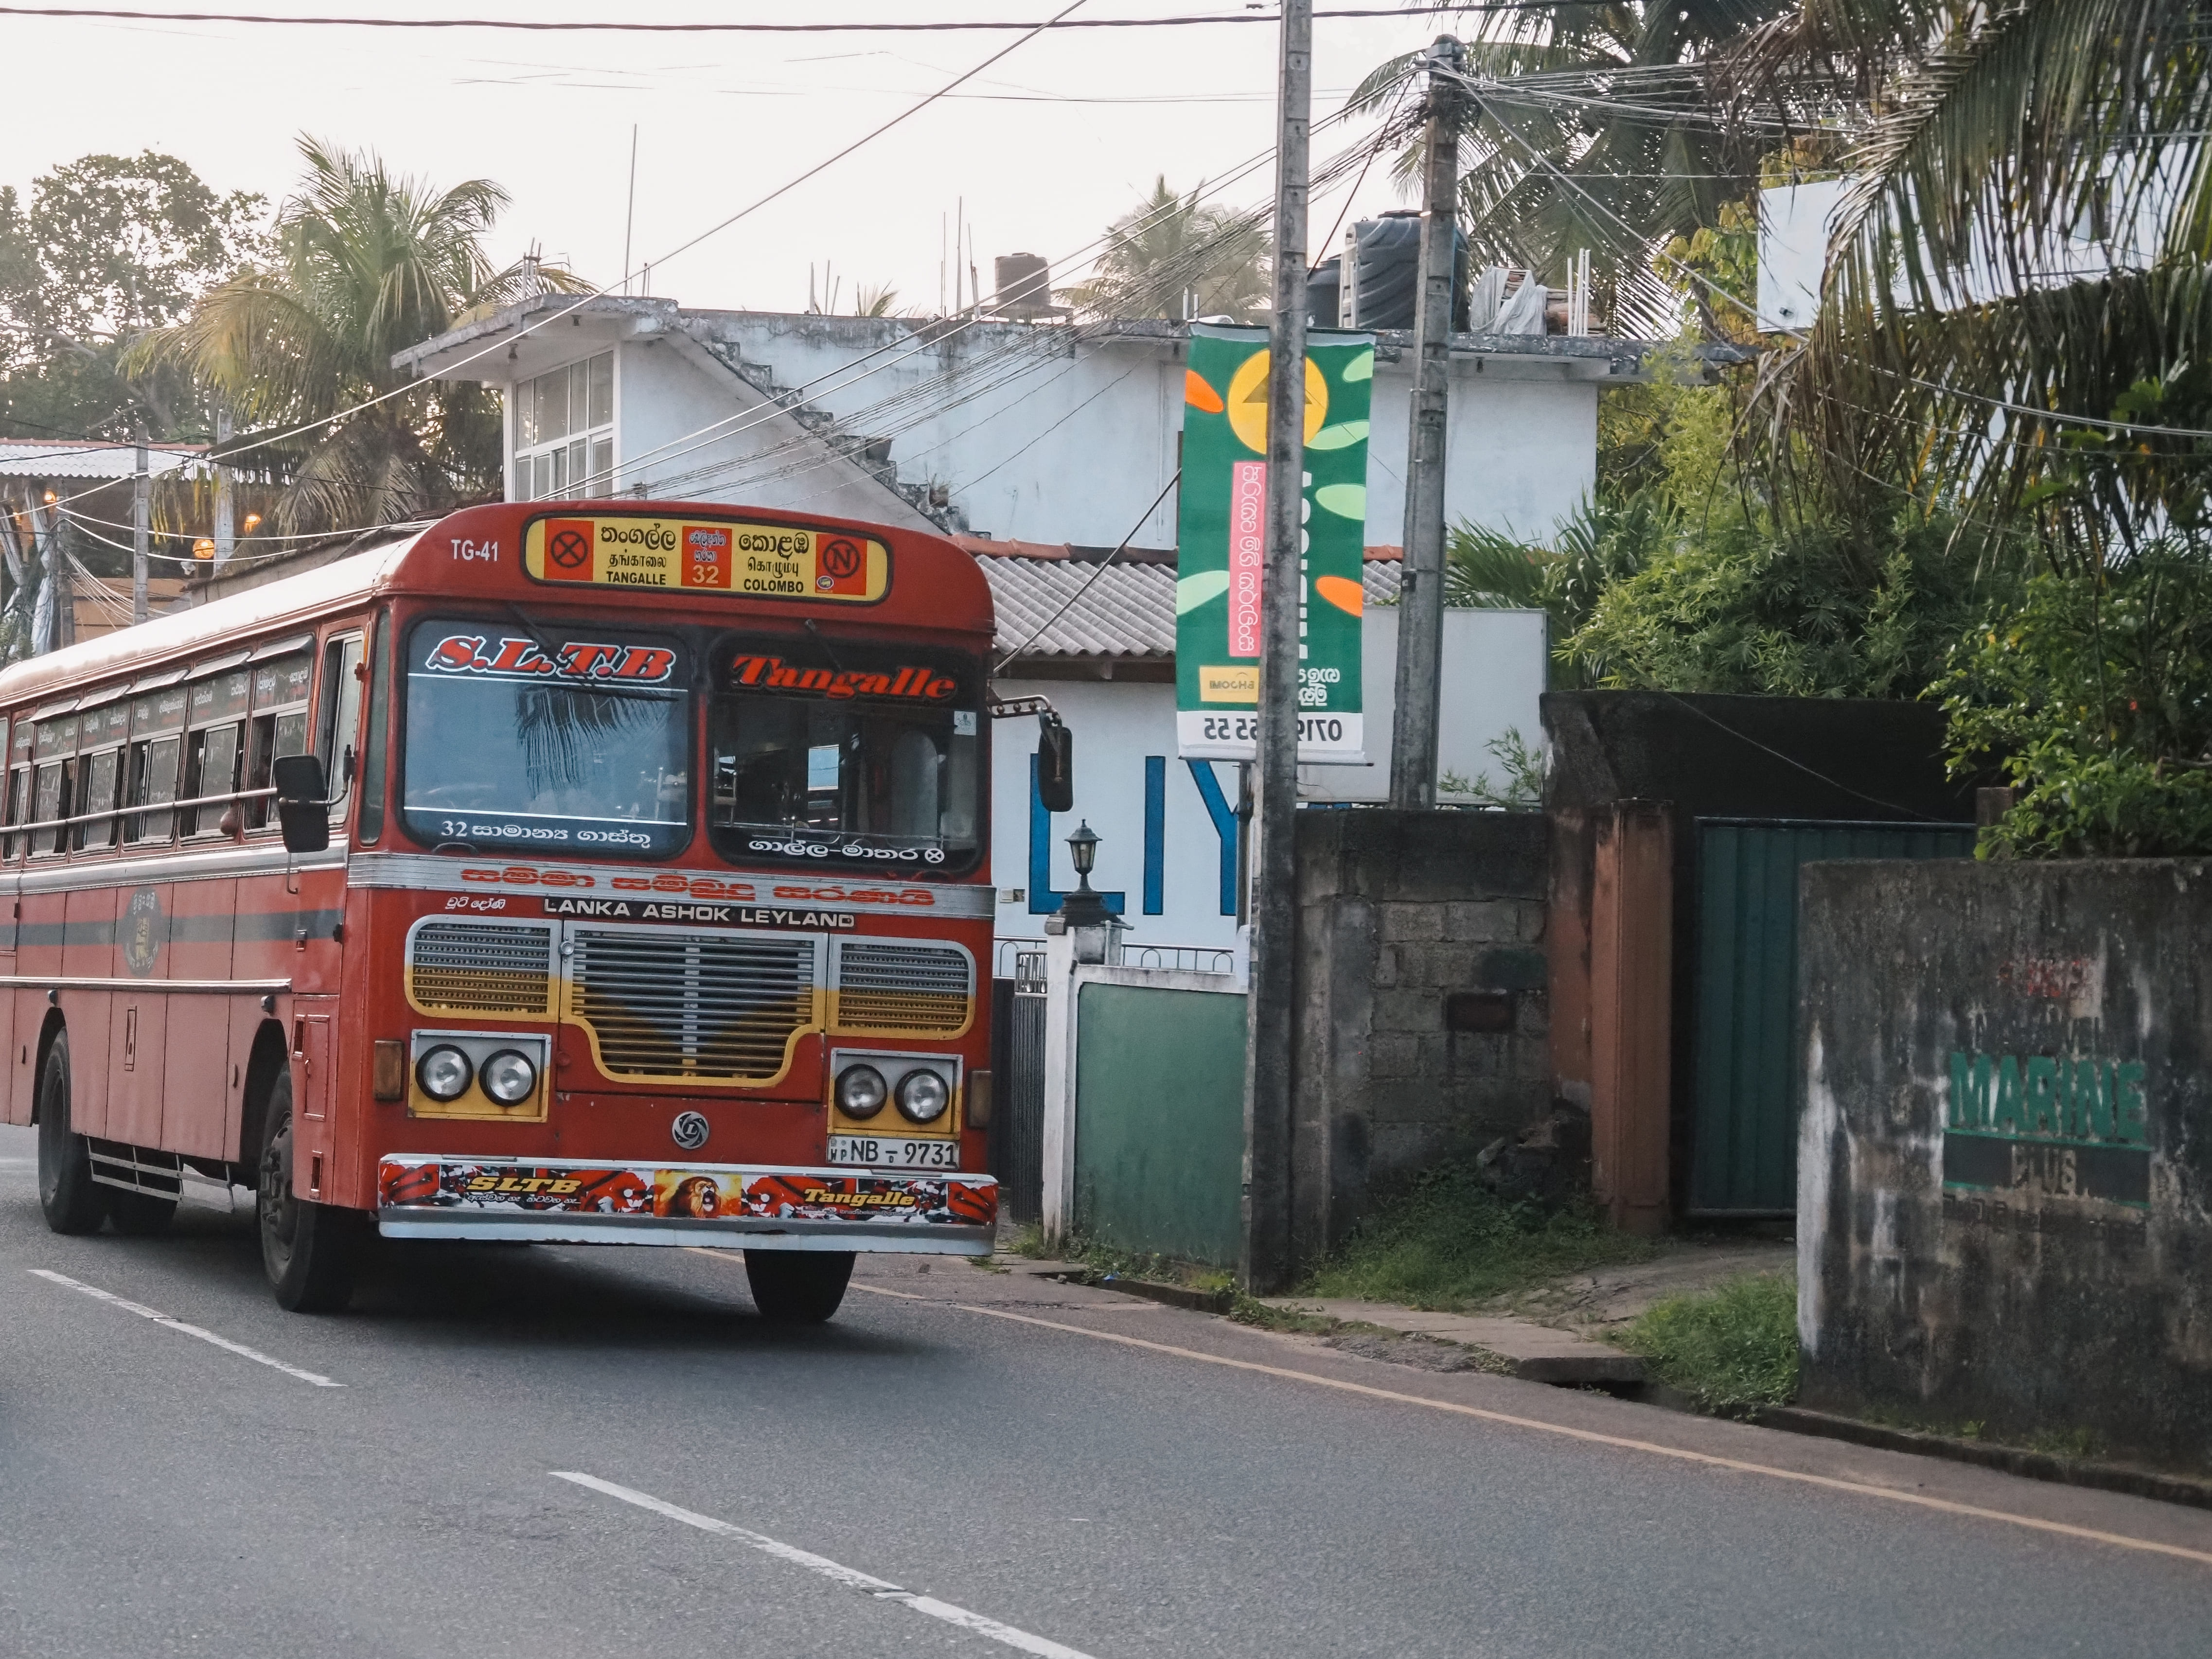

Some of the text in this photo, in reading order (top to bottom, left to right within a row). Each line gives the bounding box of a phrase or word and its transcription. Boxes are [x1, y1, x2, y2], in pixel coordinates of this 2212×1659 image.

[601, 523, 676, 550] තංගල්ල
[739, 532, 809, 558] කොළඹ
[451, 539, 498, 562] TG-41
[609, 549, 667, 568] தங்காலை
[606, 571, 667, 585] TANGALLE
[692, 564, 719, 584] 32
[743, 578, 804, 593] COLOMBO
[732, 654, 958, 700] Tangalle
[441, 821, 468, 837] 32
[544, 898, 855, 928] LANKA ASHOK LEYLAND
[1949, 1051, 2146, 1142] MARINE
[466, 1176, 582, 1193] SLTB
[804, 1188, 916, 1207] Tangalle
